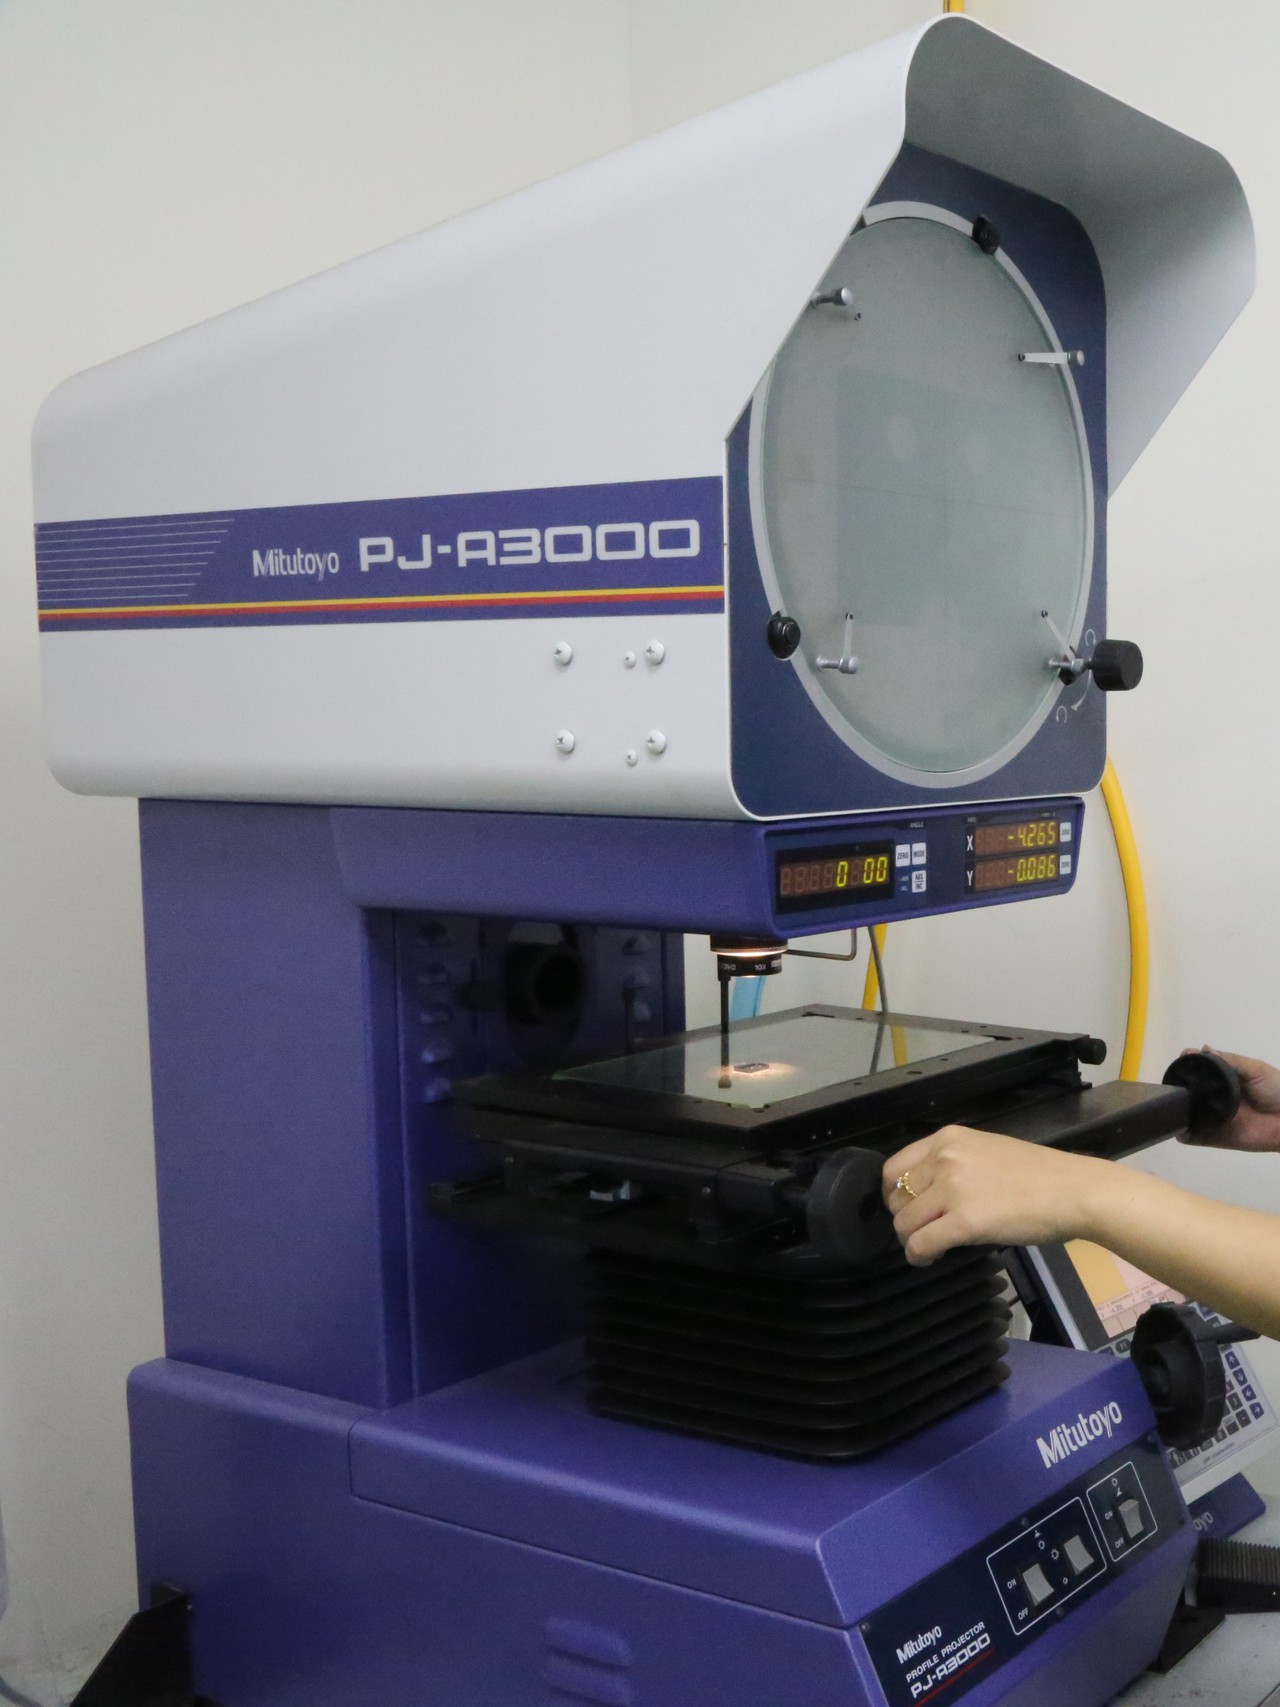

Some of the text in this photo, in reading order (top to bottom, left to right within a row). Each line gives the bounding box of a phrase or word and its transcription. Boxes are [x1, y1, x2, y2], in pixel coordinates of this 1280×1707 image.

[252, 519, 700, 582] Mitutoyo PJ-A3000
[966, 835, 974, 851] X
[897, 850, 925, 860] ZERO MODE
[966, 870, 974, 886] Y
[1035, 1401, 1123, 1470] Mitutoyo
[1104, 1510, 1114, 1520] ON
[1114, 1536, 1125, 1549] OFF
[1006, 1578, 1017, 1590] ON
[1017, 1607, 1030, 1621] OFF
[895, 1625, 943, 1665] Mitutoyo
[905, 1621, 986, 1684] PROFILE PROJECTOR
[910, 1632, 991, 1699] PJ-A3000
